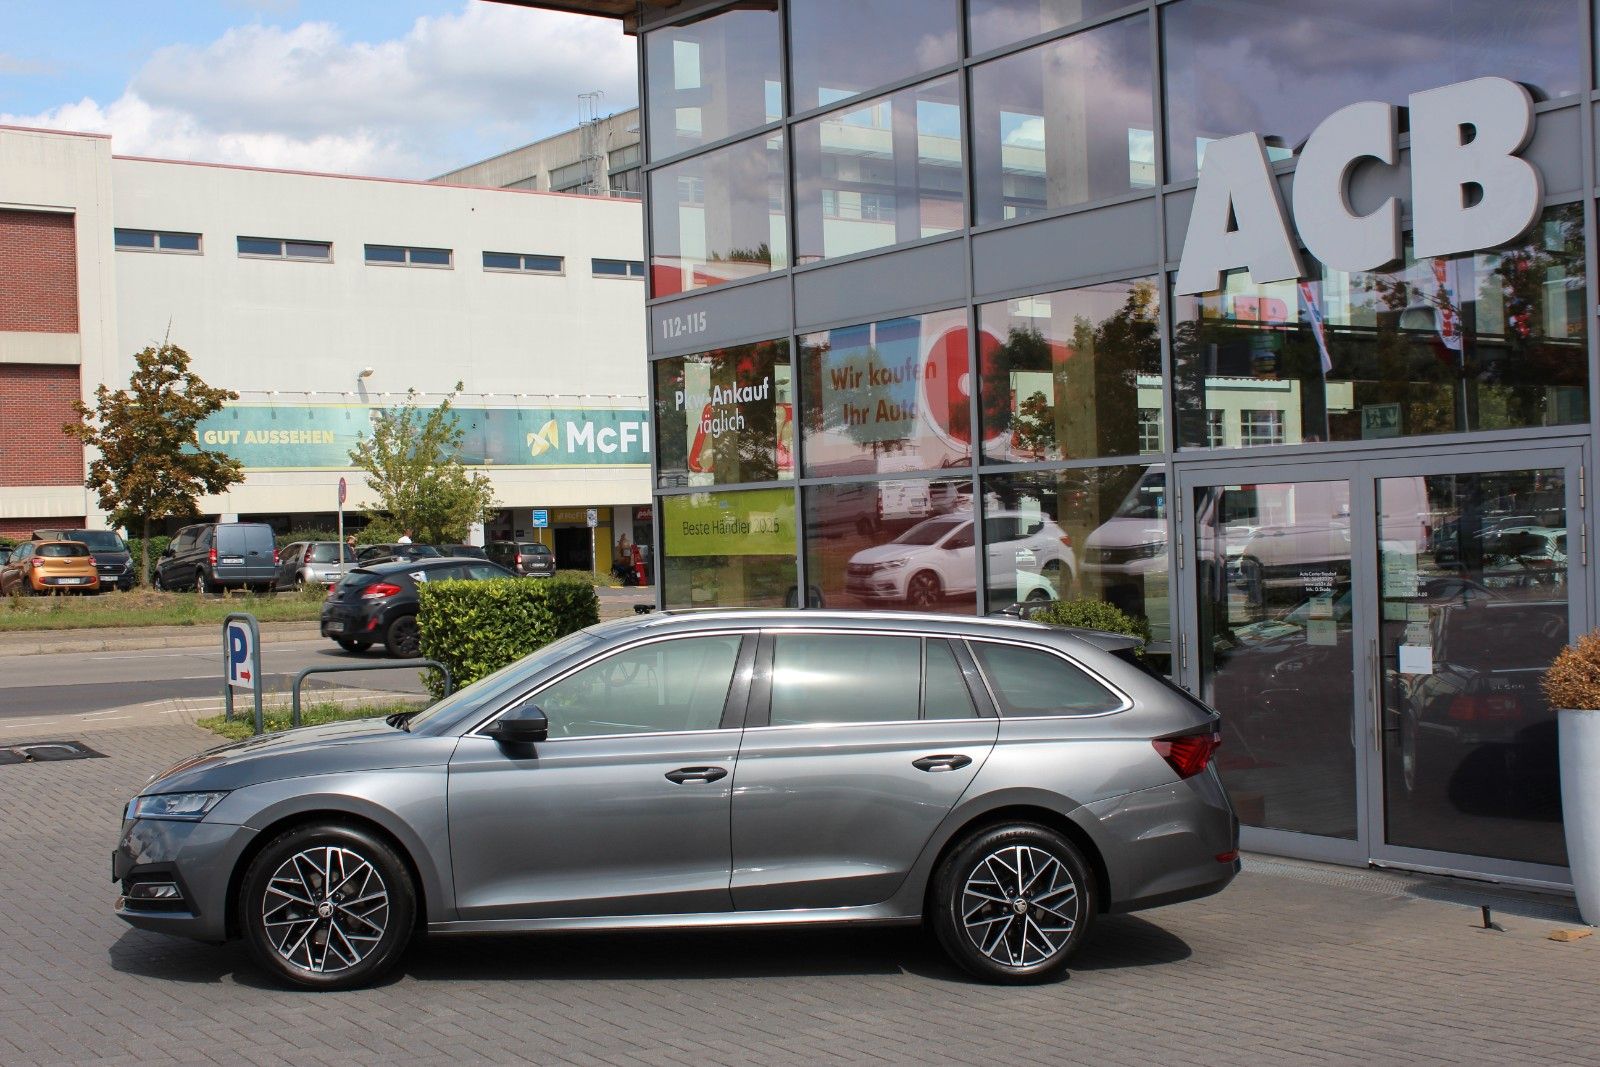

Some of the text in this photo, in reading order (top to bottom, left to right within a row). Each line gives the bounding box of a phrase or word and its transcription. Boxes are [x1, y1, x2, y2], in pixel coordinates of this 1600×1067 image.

[1174, 76, 1543, 296] ACB
[662, 311, 707, 339] 112-115
[831, 357, 937, 391] Wir kaufen
[699, 408, 745, 438] täglich
[843, 402, 869, 426] Ihr
[204, 430, 240, 445] GUT
[244, 430, 334, 445] AUSSEHEN
[682, 521, 710, 536] Beste
[712, 518, 750, 535] Händler
[229, 626, 247, 680] P
